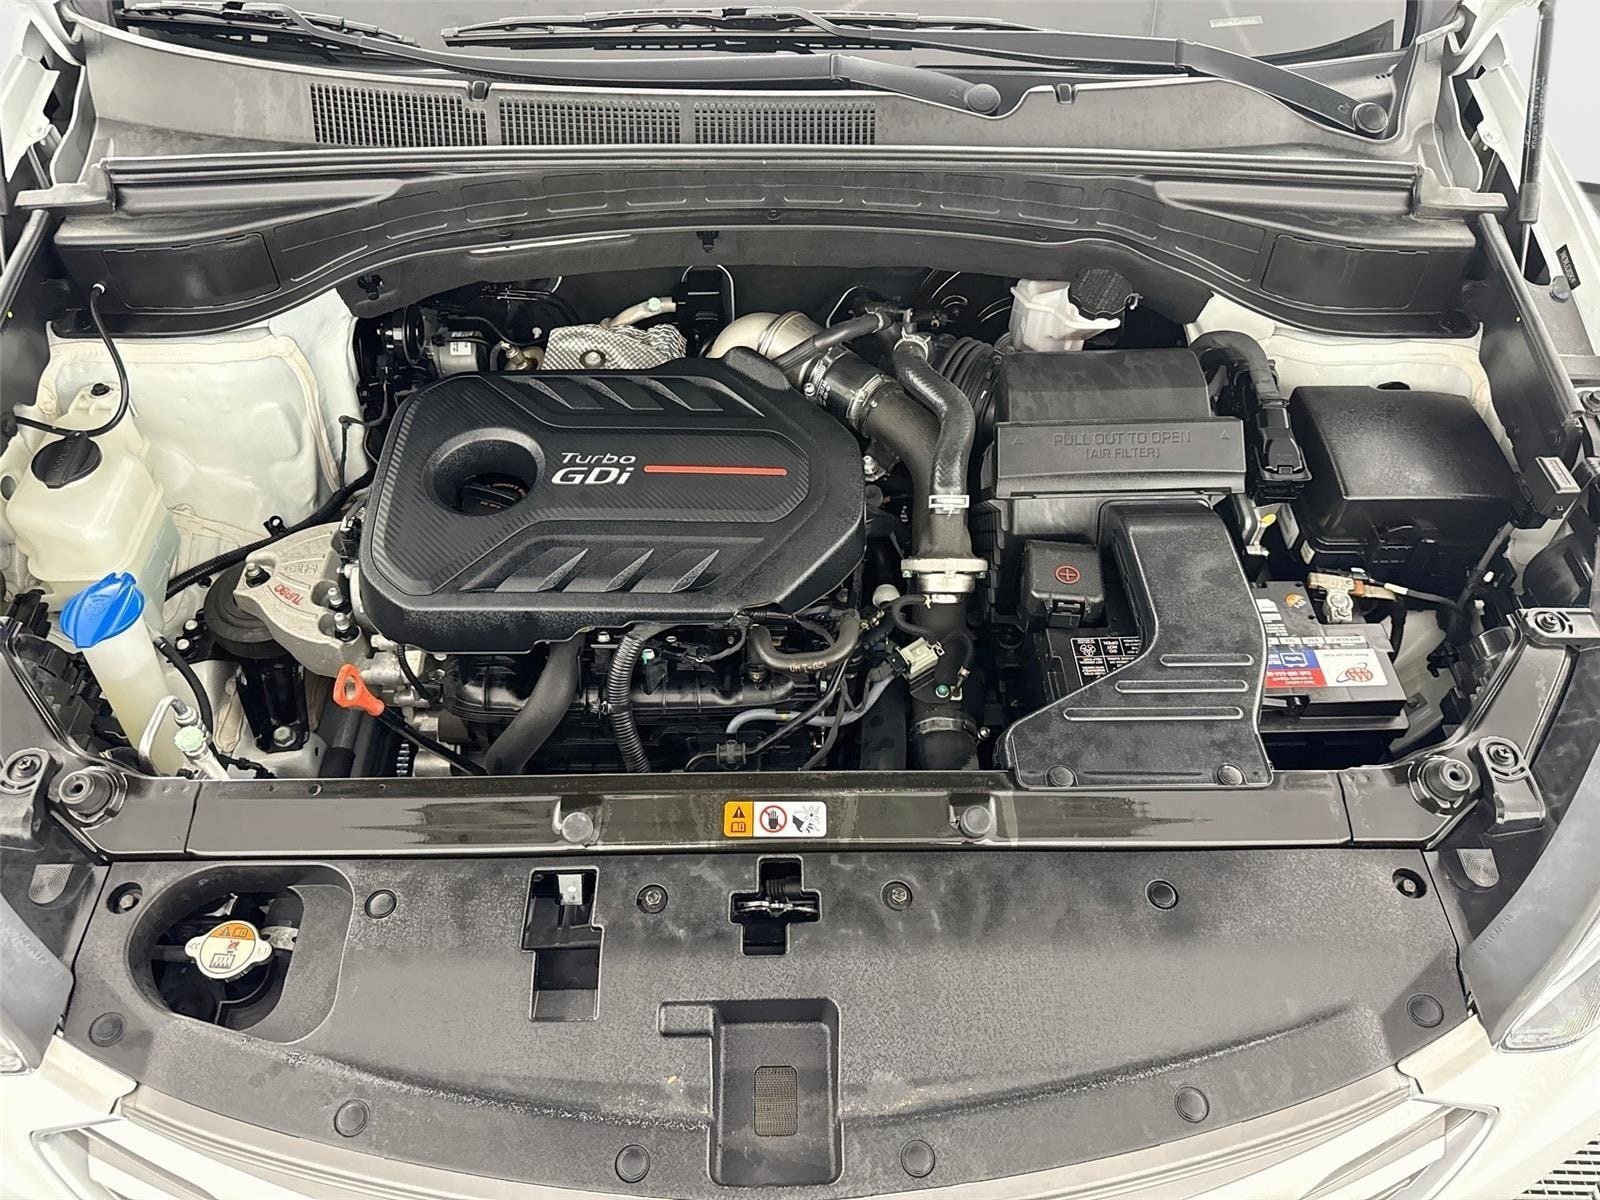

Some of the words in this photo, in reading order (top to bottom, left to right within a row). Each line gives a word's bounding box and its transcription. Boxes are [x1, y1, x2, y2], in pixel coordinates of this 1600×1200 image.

[1053, 434, 1092, 446] PULL
[1095, 432, 1124, 446] OUT
[1128, 431, 1149, 445] TO
[1152, 430, 1191, 444] OPEN
[561, 452, 636, 464] Turbo
[1085, 447, 1111, 459] (AIR
[1114, 446, 1160, 459] FILTER)
[551, 466, 635, 485] GDi
[274, 584, 304, 605] TURBO
